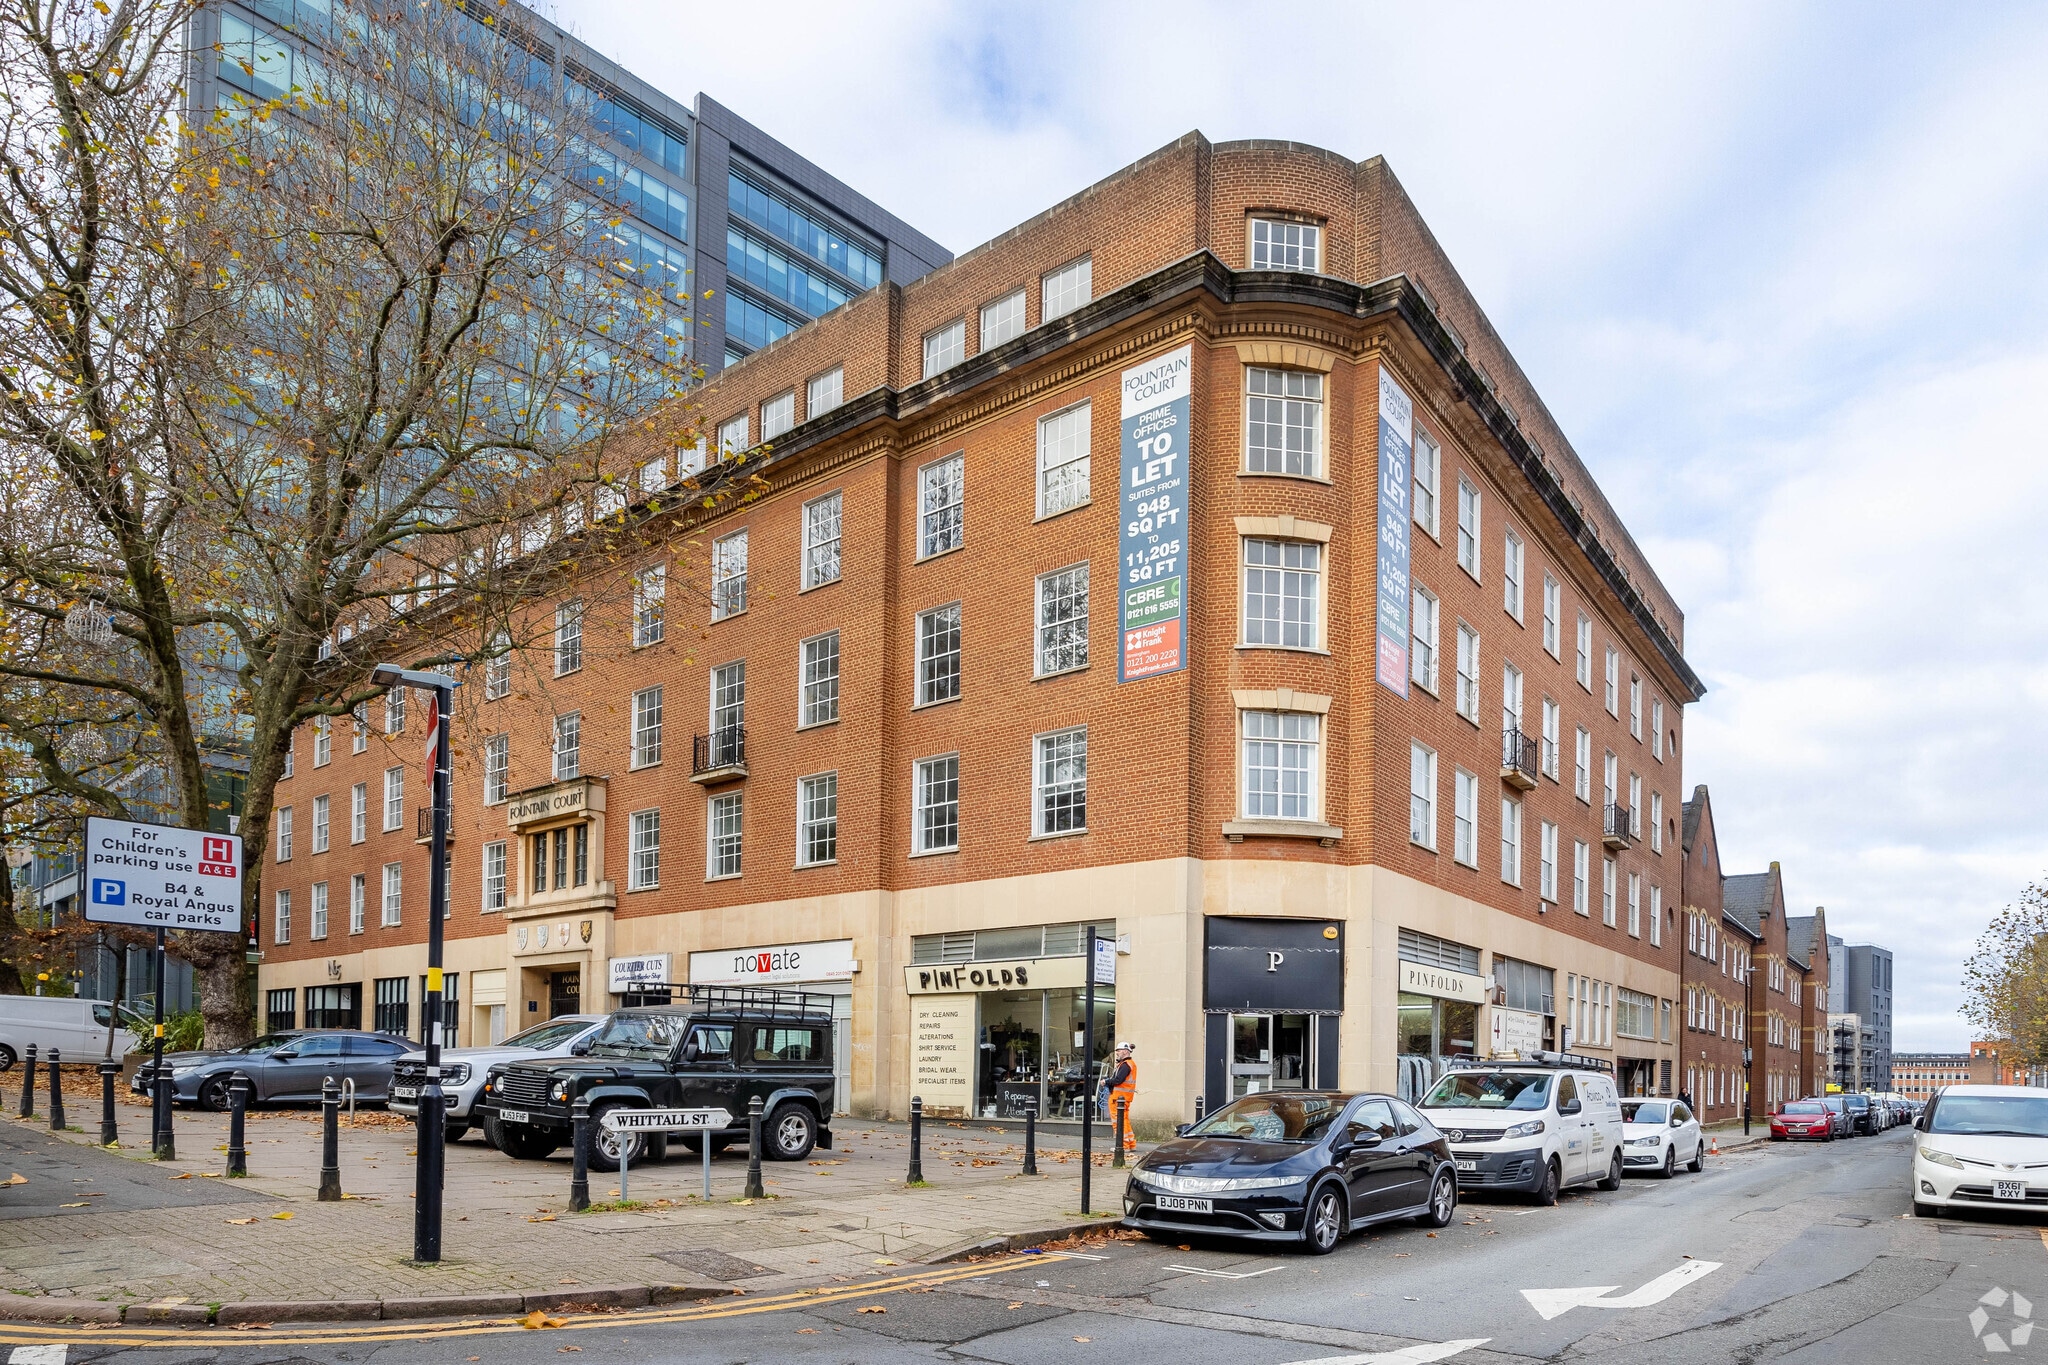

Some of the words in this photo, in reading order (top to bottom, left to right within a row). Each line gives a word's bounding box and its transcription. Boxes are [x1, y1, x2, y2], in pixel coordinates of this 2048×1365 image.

[1124, 356, 1188, 392] FOUNTAIN
[1134, 375, 1177, 402] COURT
[1380, 377, 1411, 421] FOUNTAIN
[1139, 405, 1172, 426] PRIME
[1385, 399, 1405, 428] COURT
[1133, 415, 1177, 440] OFFICES
[1387, 426, 1404, 449] PRIME
[1137, 432, 1172, 461] TO
[1384, 436, 1406, 465] OFFICES
[1131, 452, 1178, 488] LET
[1386, 451, 1404, 484] TO
[1128, 486, 1155, 502] SUITES
[1157, 477, 1181, 492] FROM
[1383, 472, 1406, 509] LET
[1137, 494, 1171, 518] 948
[1128, 517, 1153, 538] SQ
[1156, 508, 1180, 530] FT
[1386, 514, 1403, 538] 948
[1147, 534, 1159, 544] TO
[1381, 527, 1395, 550] SQ
[1395, 539, 1407, 559] FT
[1126, 539, 1181, 567] 11,205
[1129, 564, 1152, 584] SQ
[1155, 557, 1177, 577] FT
[1380, 556, 1407, 589] 11,205
[1127, 585, 1166, 606] CBRE
[1382, 575, 1395, 596] SQ
[1395, 585, 1406, 603] FT
[1127, 608, 1144, 620] 0121
[1144, 604, 1158, 615] 616
[1159, 598, 1179, 611] 5555
[1381, 599, 1400, 622] CBRE
[1142, 626, 1166, 639] Knight
[1142, 636, 1162, 648] Frank
[1126, 657, 1144, 668] 0121
[1145, 653, 1159, 664] 200
[1159, 649, 1178, 661] 2220
[1126, 659, 1178, 676] KnightFrank.co.uk
[510, 799, 550, 819] FOUNTAIN
[553, 791, 584, 809] COURT
[131, 827, 159, 841] For
[101, 837, 187, 858] Children's
[208, 840, 228, 861] H
[94, 853, 158, 870] parking
[165, 861, 193, 872] use
[203, 864, 211, 874] A
[213, 865, 222, 875] &
[224, 866, 232, 876] E
[100, 881, 121, 902] P
[165, 883, 188, 895] B4
[194, 885, 205, 896] &
[132, 893, 179, 909] Royal
[185, 899, 235, 913] Angus
[144, 910, 170, 921] car
[177, 913, 222, 925] parks
[646, 959, 663, 971] CUTS
[734, 949, 801, 974] novate
[1267, 951, 1284, 971] P
[919, 966, 1028, 990] PINFOLDS
[1409, 970, 1464, 992] PINFOLDS
[1494, 1014, 1500, 1039] 4
[616, 1114, 689, 1127] WHITTALL
[692, 1114, 710, 1125] ST.
[1457, 1161, 1472, 1169] PUY
[1998, 1181, 2021, 1190] BX61
[2000, 1190, 2020, 1198] RXY
[1160, 1197, 1185, 1209] BJ08
[1187, 1200, 1208, 1211] PNN
